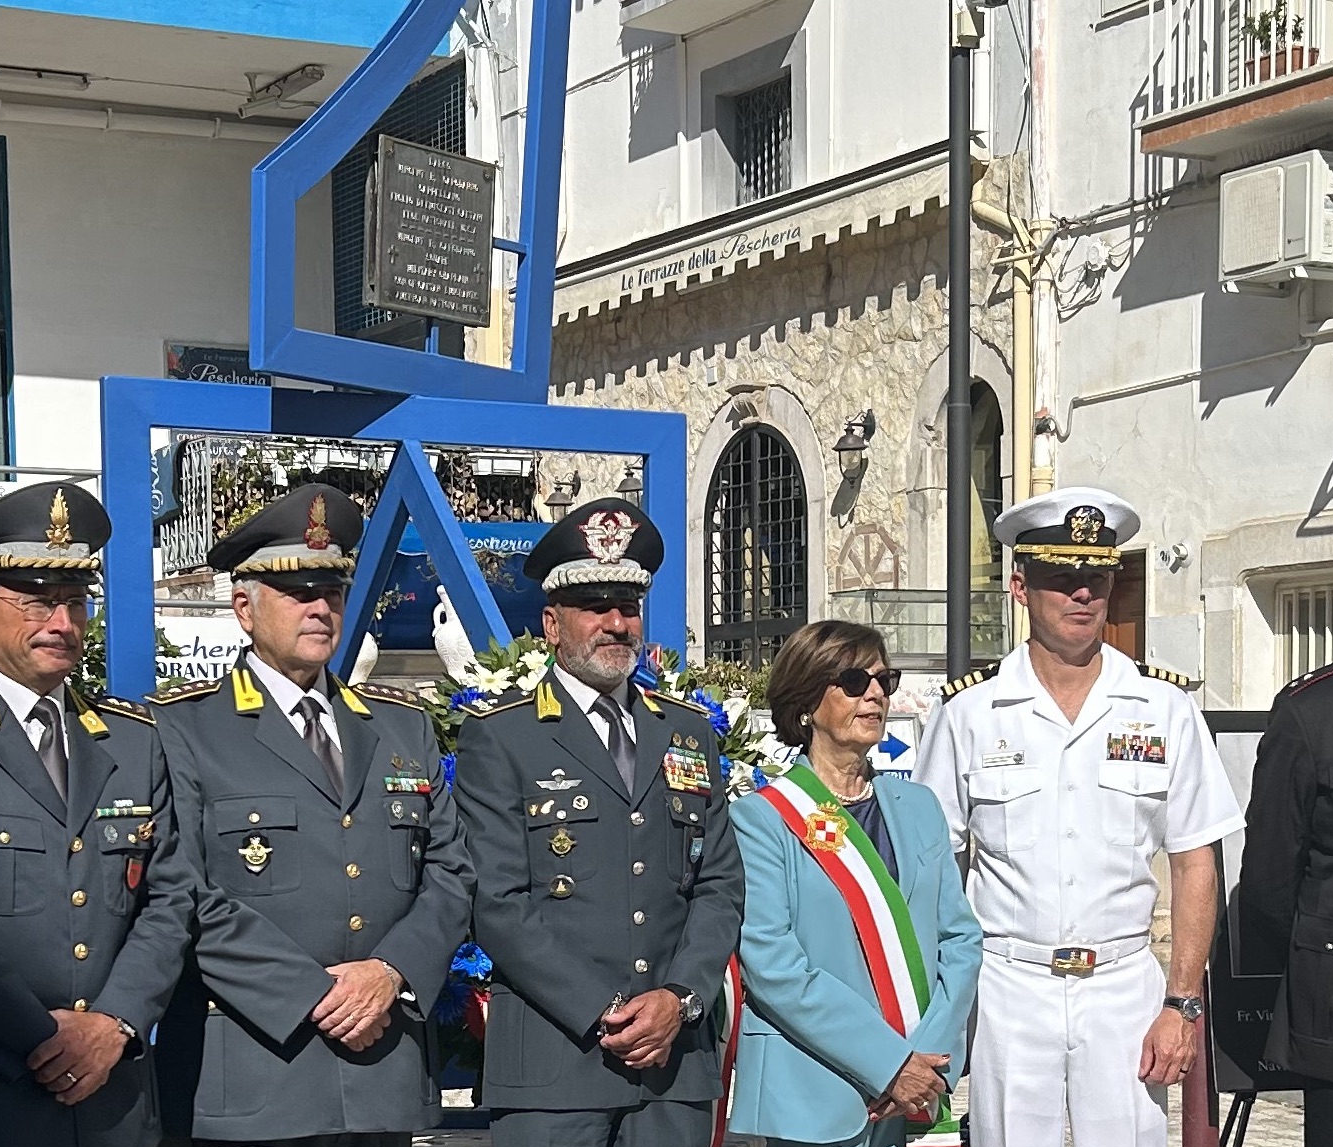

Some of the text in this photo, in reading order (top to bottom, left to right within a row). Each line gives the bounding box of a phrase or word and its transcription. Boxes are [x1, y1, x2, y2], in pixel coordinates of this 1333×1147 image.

[621, 223, 801, 292] Le Terrazze della Pescheria
[187, 362, 266, 385] Pescheria
[465, 536, 533, 552] escheria
[1237, 1010, 1254, 1022] Fr.
